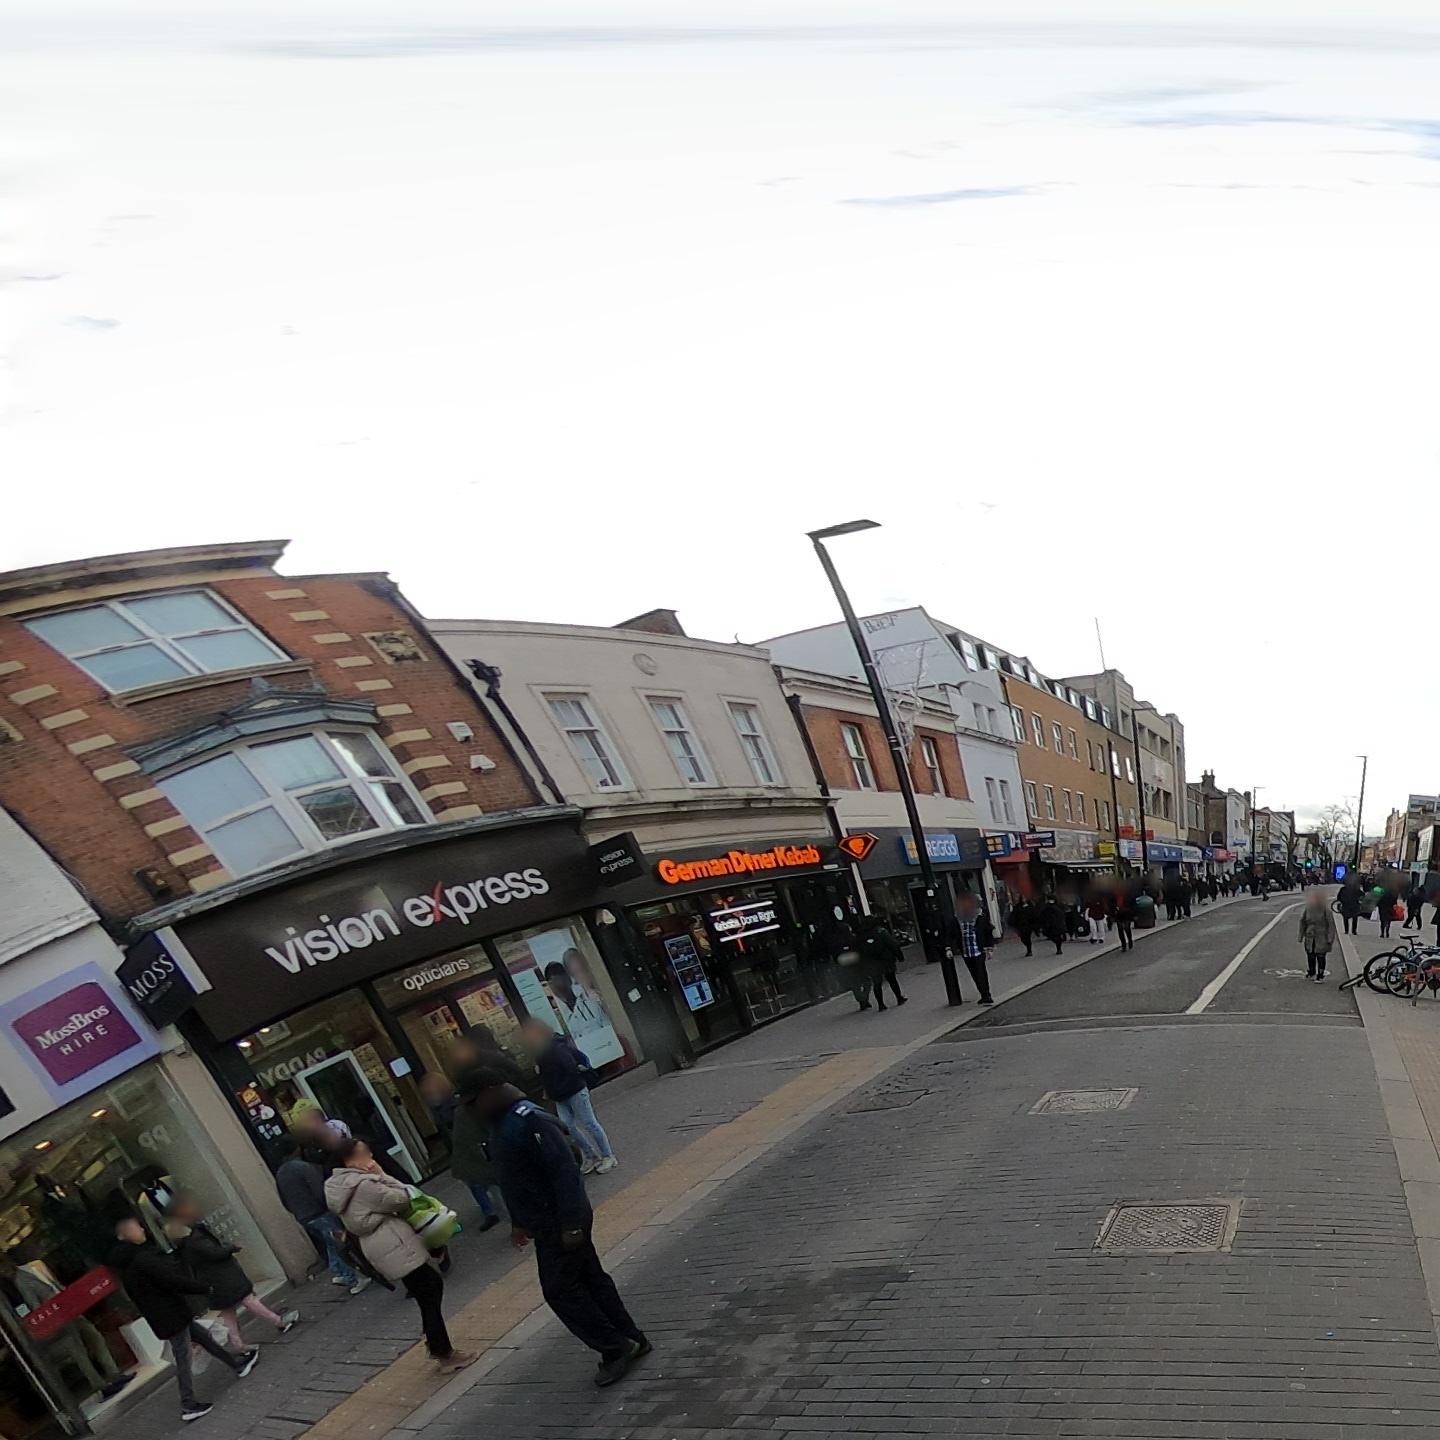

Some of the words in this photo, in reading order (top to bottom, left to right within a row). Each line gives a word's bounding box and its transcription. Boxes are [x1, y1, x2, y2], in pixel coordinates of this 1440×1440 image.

[657, 857, 733, 885] German
[773, 844, 821, 867] Kebab
[921, 840, 958, 857] REGGS
[264, 913, 401, 974] vision
[402, 868, 550, 925] express
[129, 953, 176, 1001] MOSS
[403, 957, 470, 991] opticians
[59, 1024, 109, 1056] HIRE
